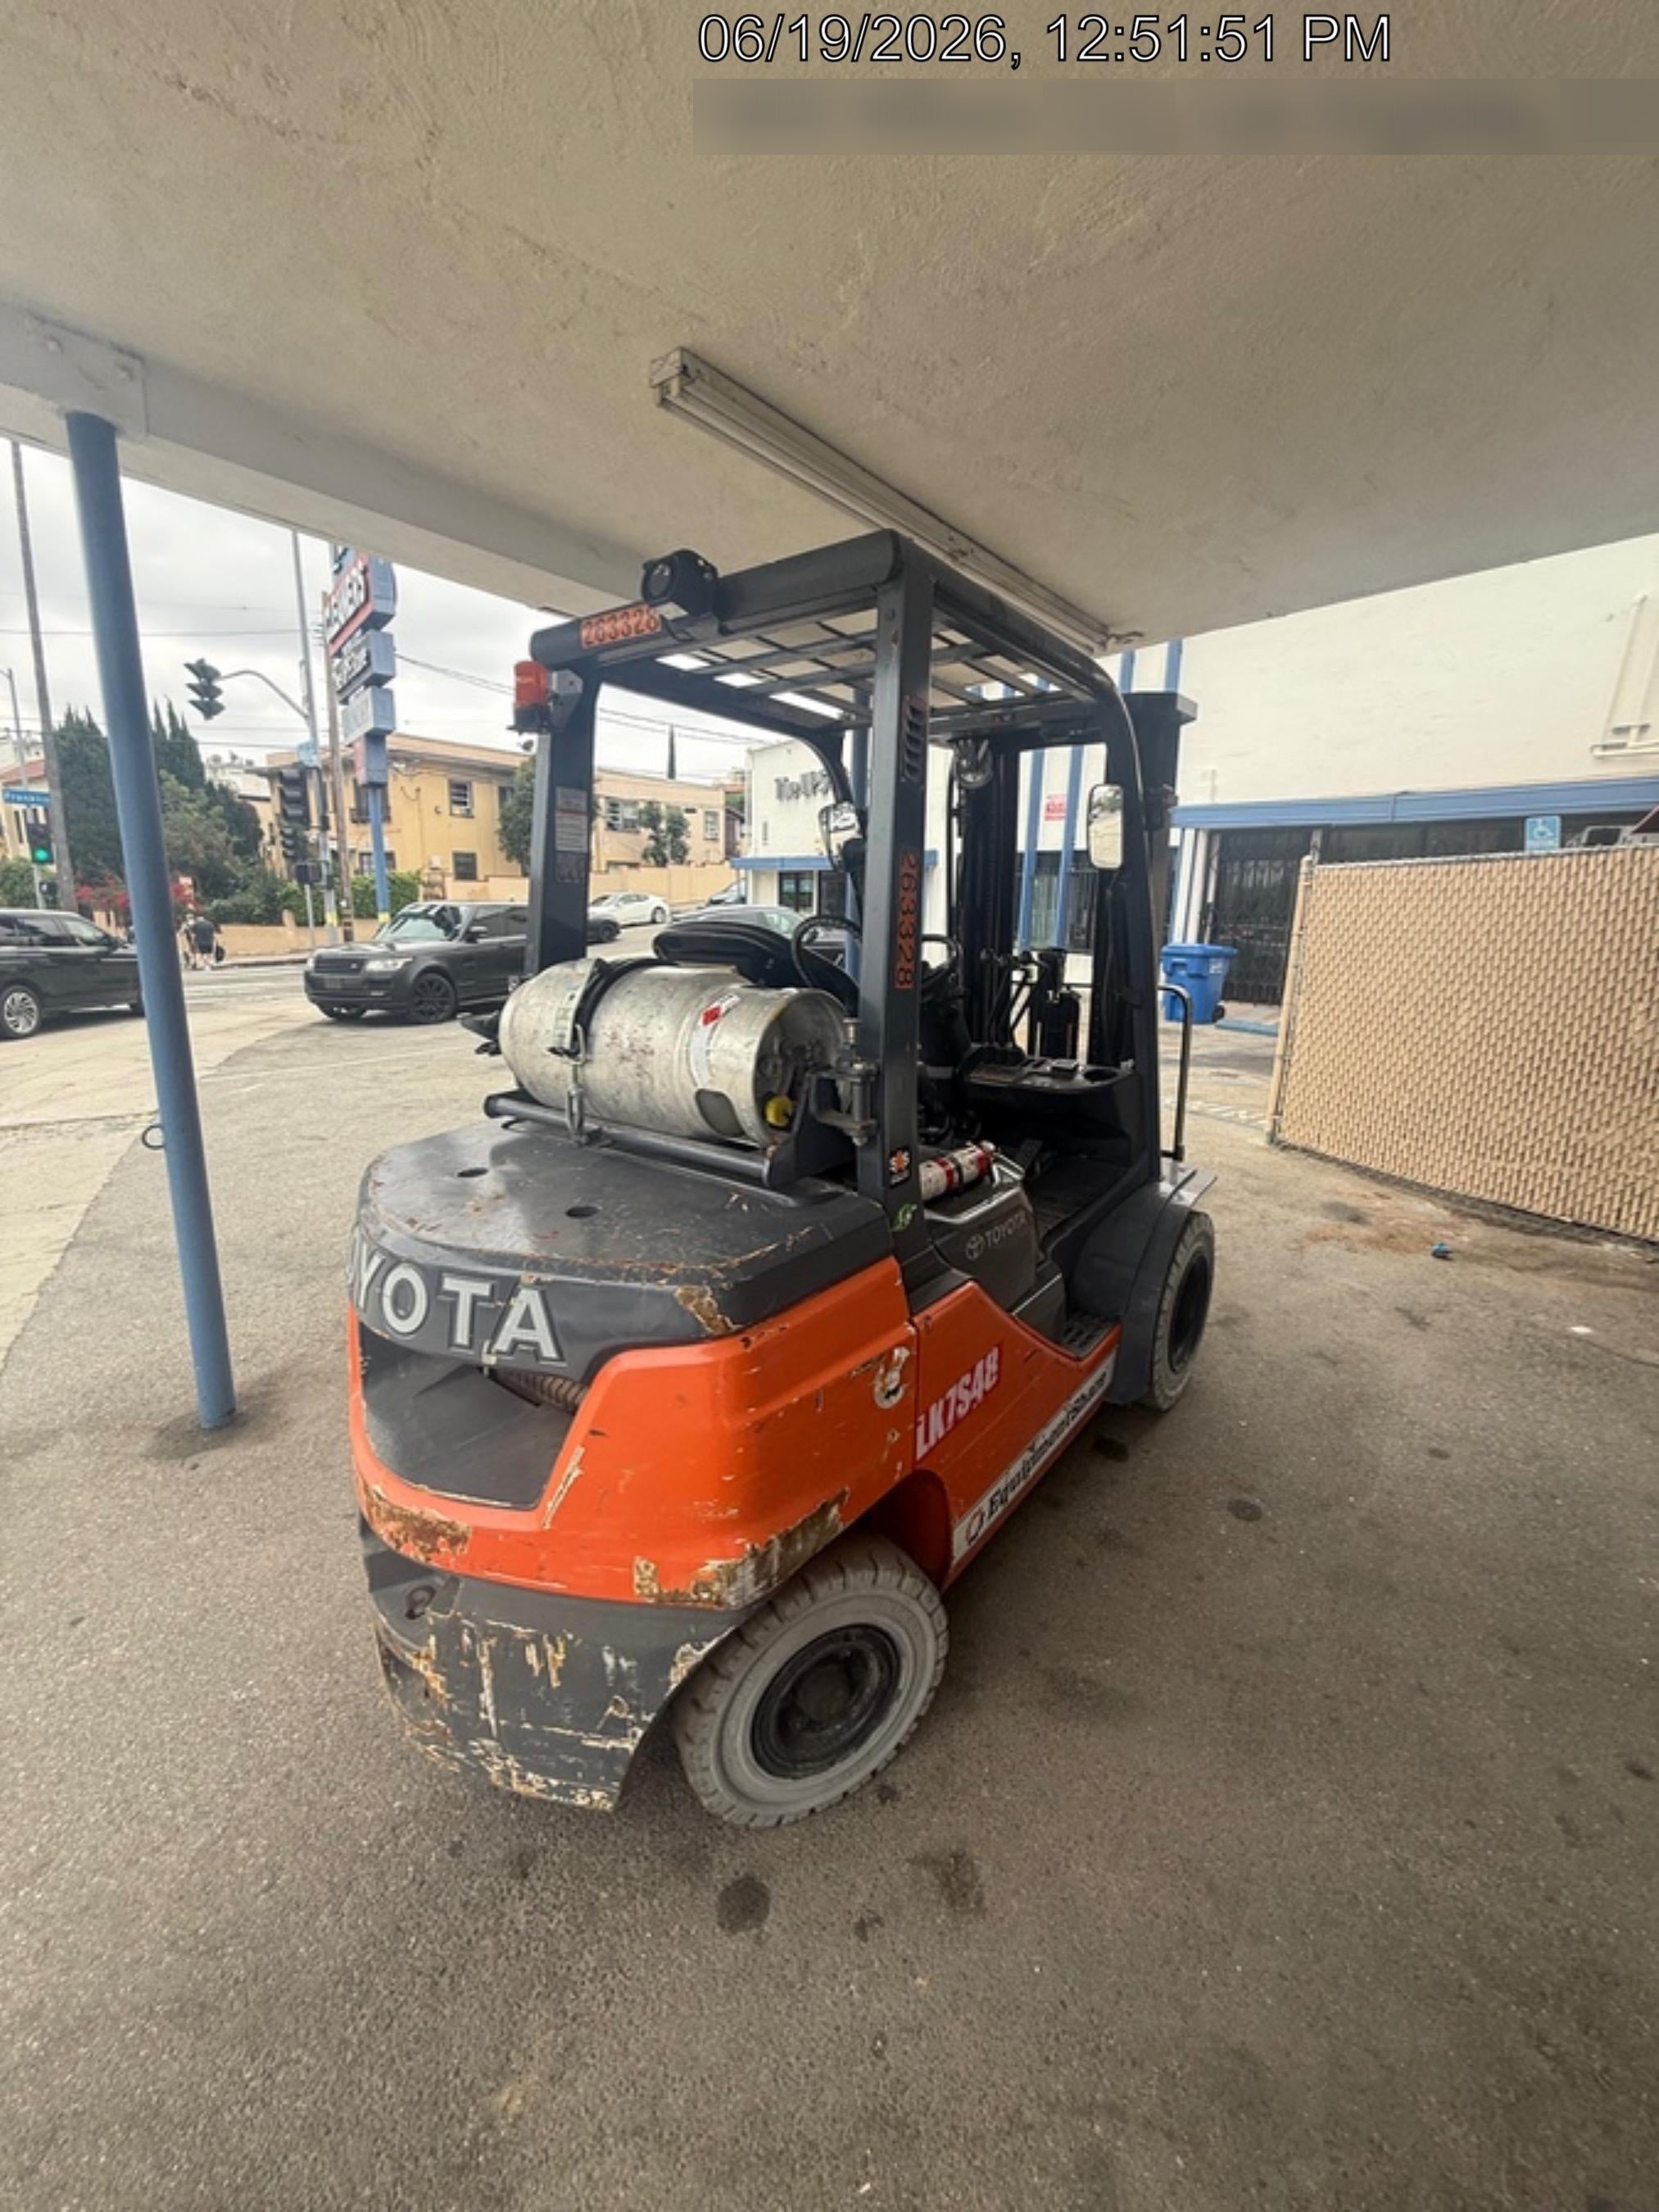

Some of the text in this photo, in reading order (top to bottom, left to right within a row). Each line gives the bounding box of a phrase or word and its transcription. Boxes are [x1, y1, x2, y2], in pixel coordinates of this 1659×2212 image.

[900, 853, 917, 986] 263328
[354, 1229, 561, 1359] YOTA
[985, 1213, 1025, 1246] TOYOTA
